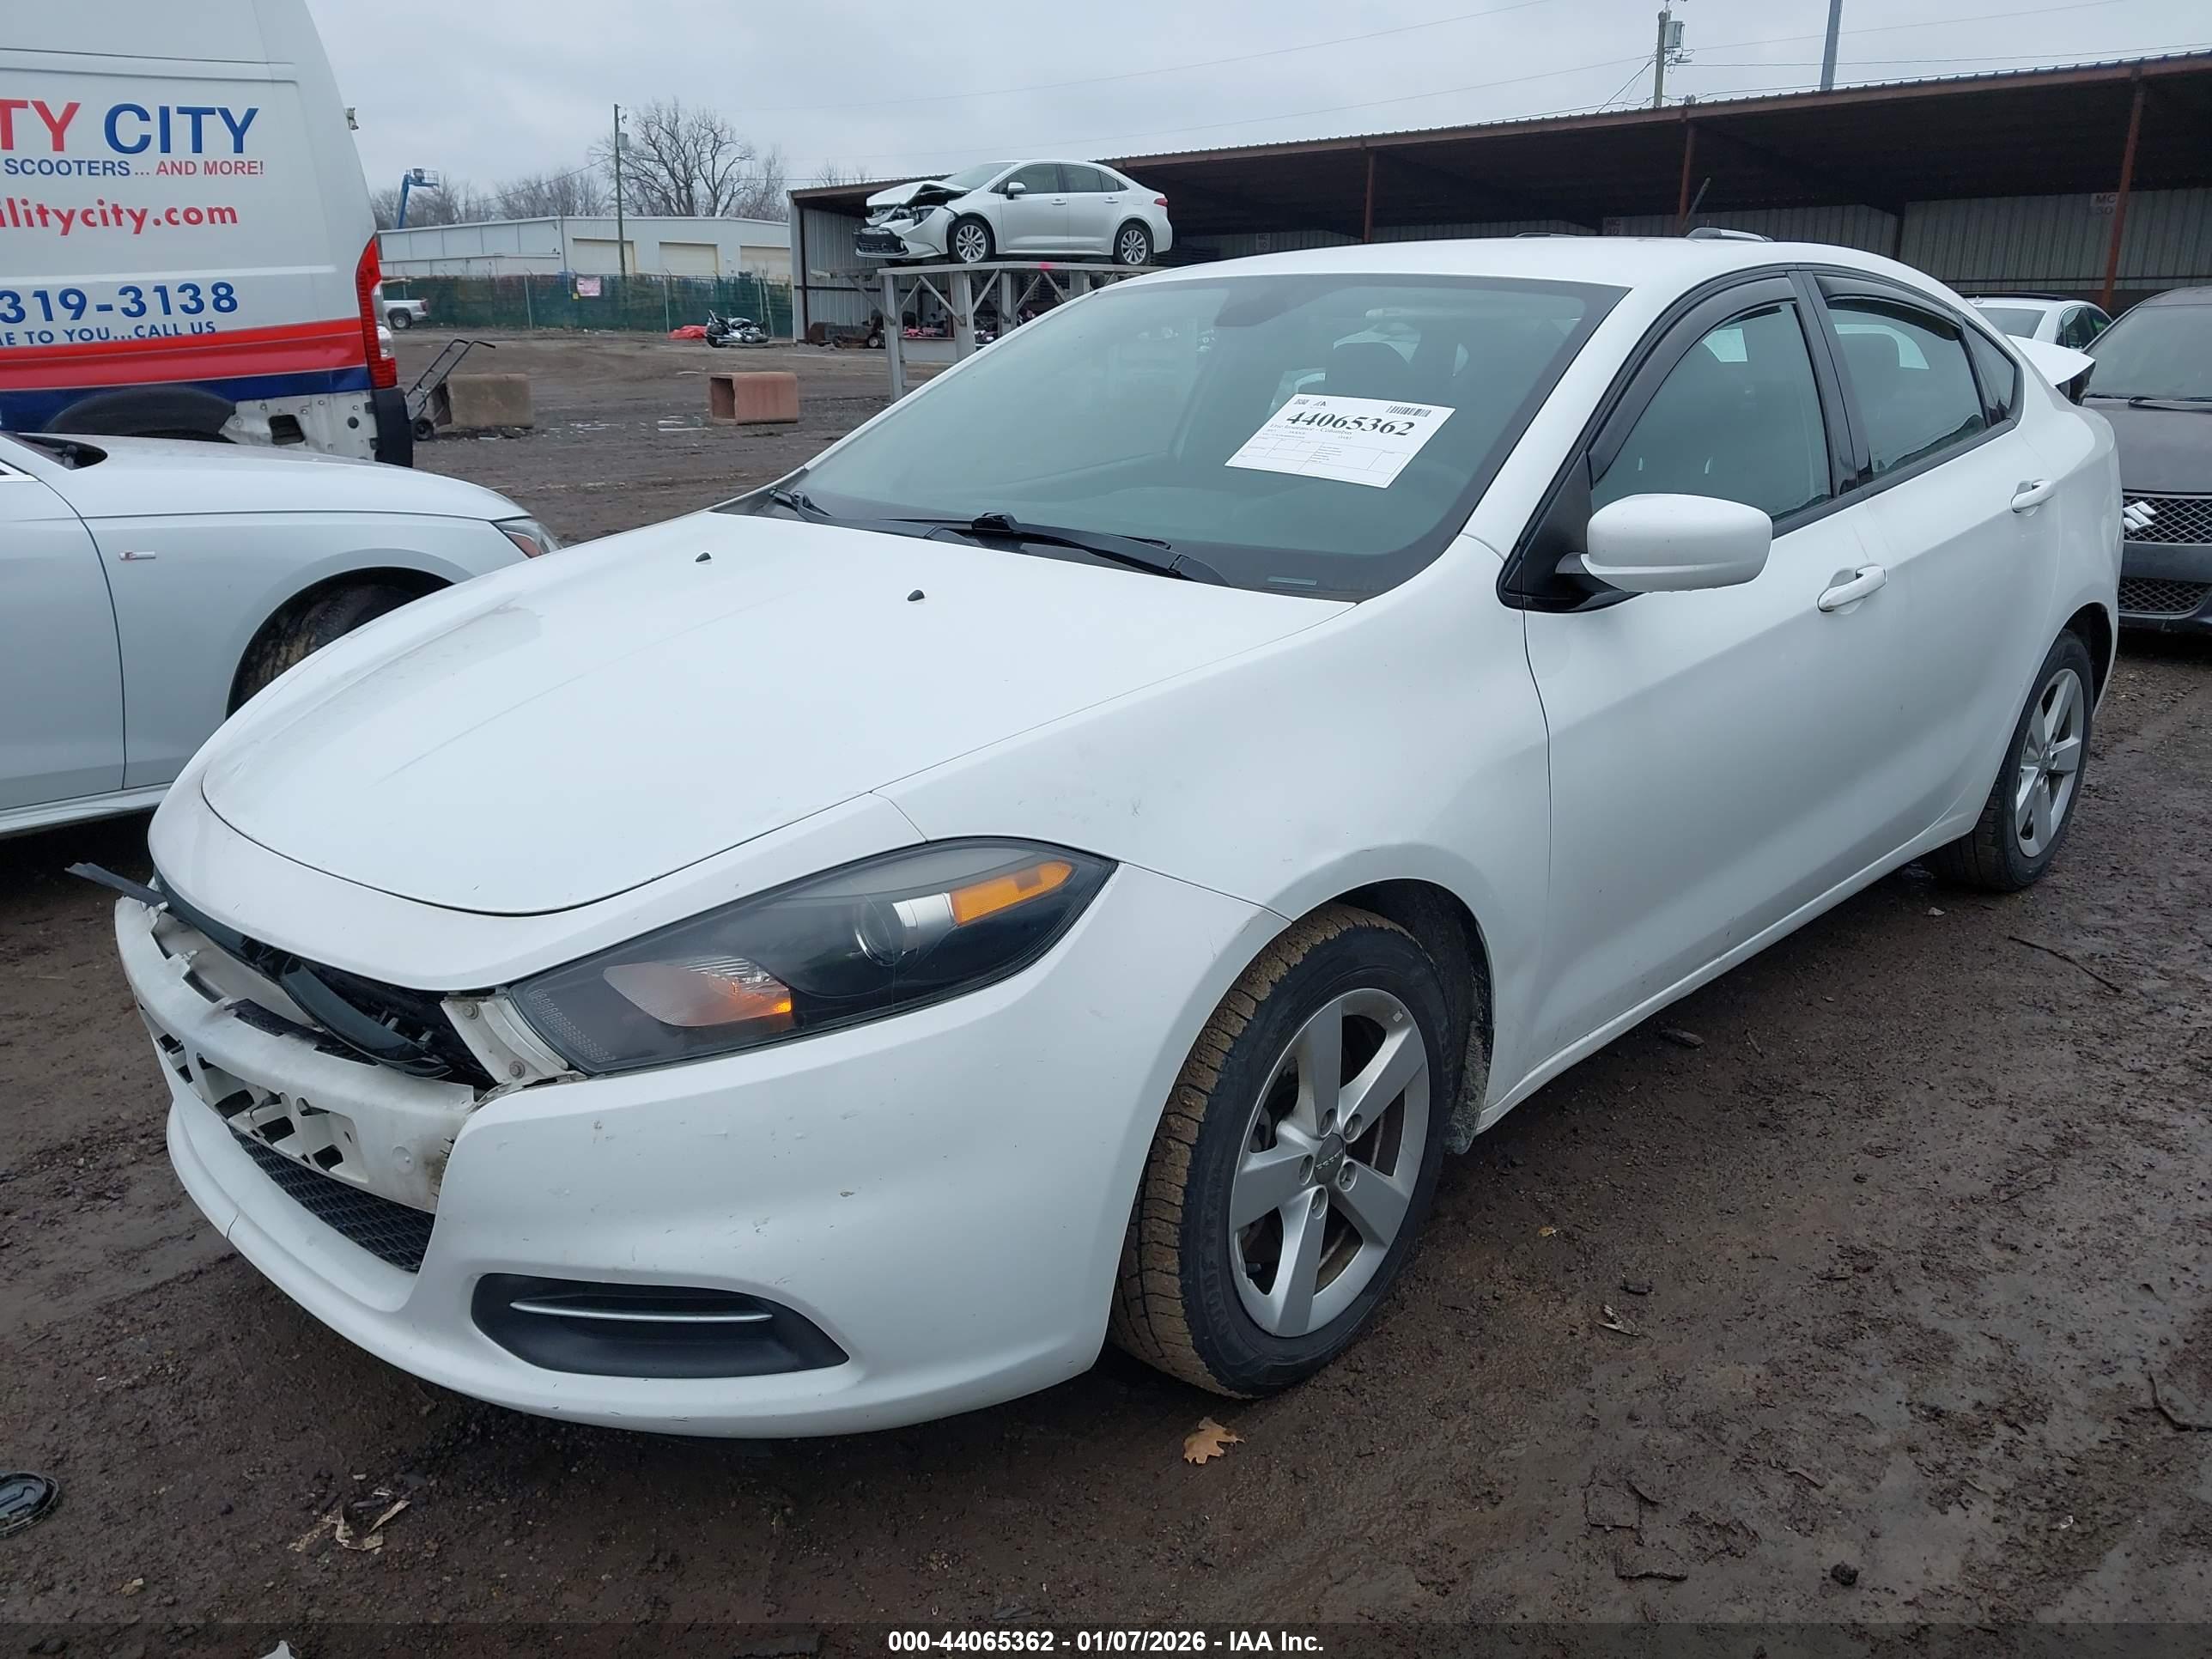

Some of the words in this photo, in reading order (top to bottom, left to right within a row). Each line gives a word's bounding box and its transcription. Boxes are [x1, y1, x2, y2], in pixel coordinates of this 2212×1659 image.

[104, 103, 259, 155] CITY
[156, 161, 197, 176] AND
[204, 161, 264, 176] MORE!
[0, 282, 239, 325] 319-3138
[0, 332, 16, 346] E
[24, 331, 54, 344] TO
[190, 321, 216, 335] US
[1286, 411, 1415, 437] 44065362
